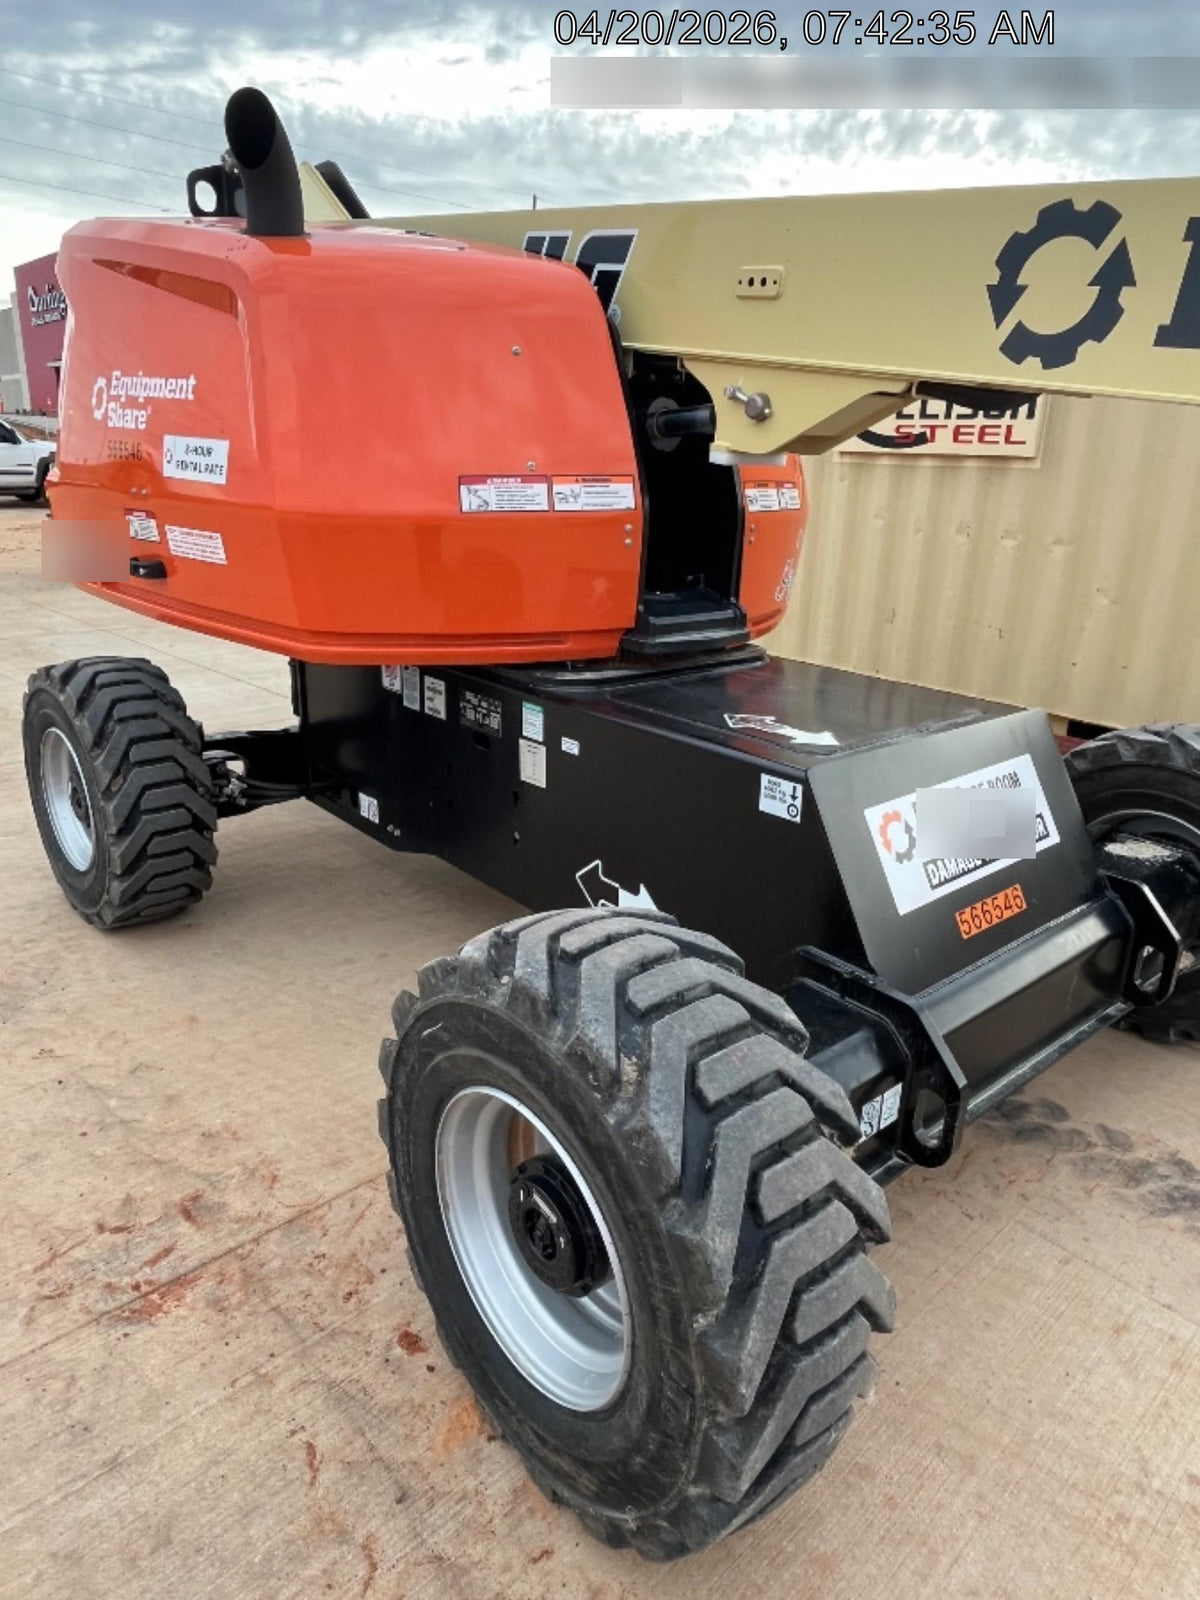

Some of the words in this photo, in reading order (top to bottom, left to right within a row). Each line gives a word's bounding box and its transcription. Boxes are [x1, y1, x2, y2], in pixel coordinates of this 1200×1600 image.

[109, 370, 197, 403] Equipment
[107, 401, 148, 429] Share
[893, 424, 1026, 445] STEEL
[175, 459, 203, 474] RENTAL
[203, 463, 225, 476] RATE
[958, 888, 1025, 936] 566546
